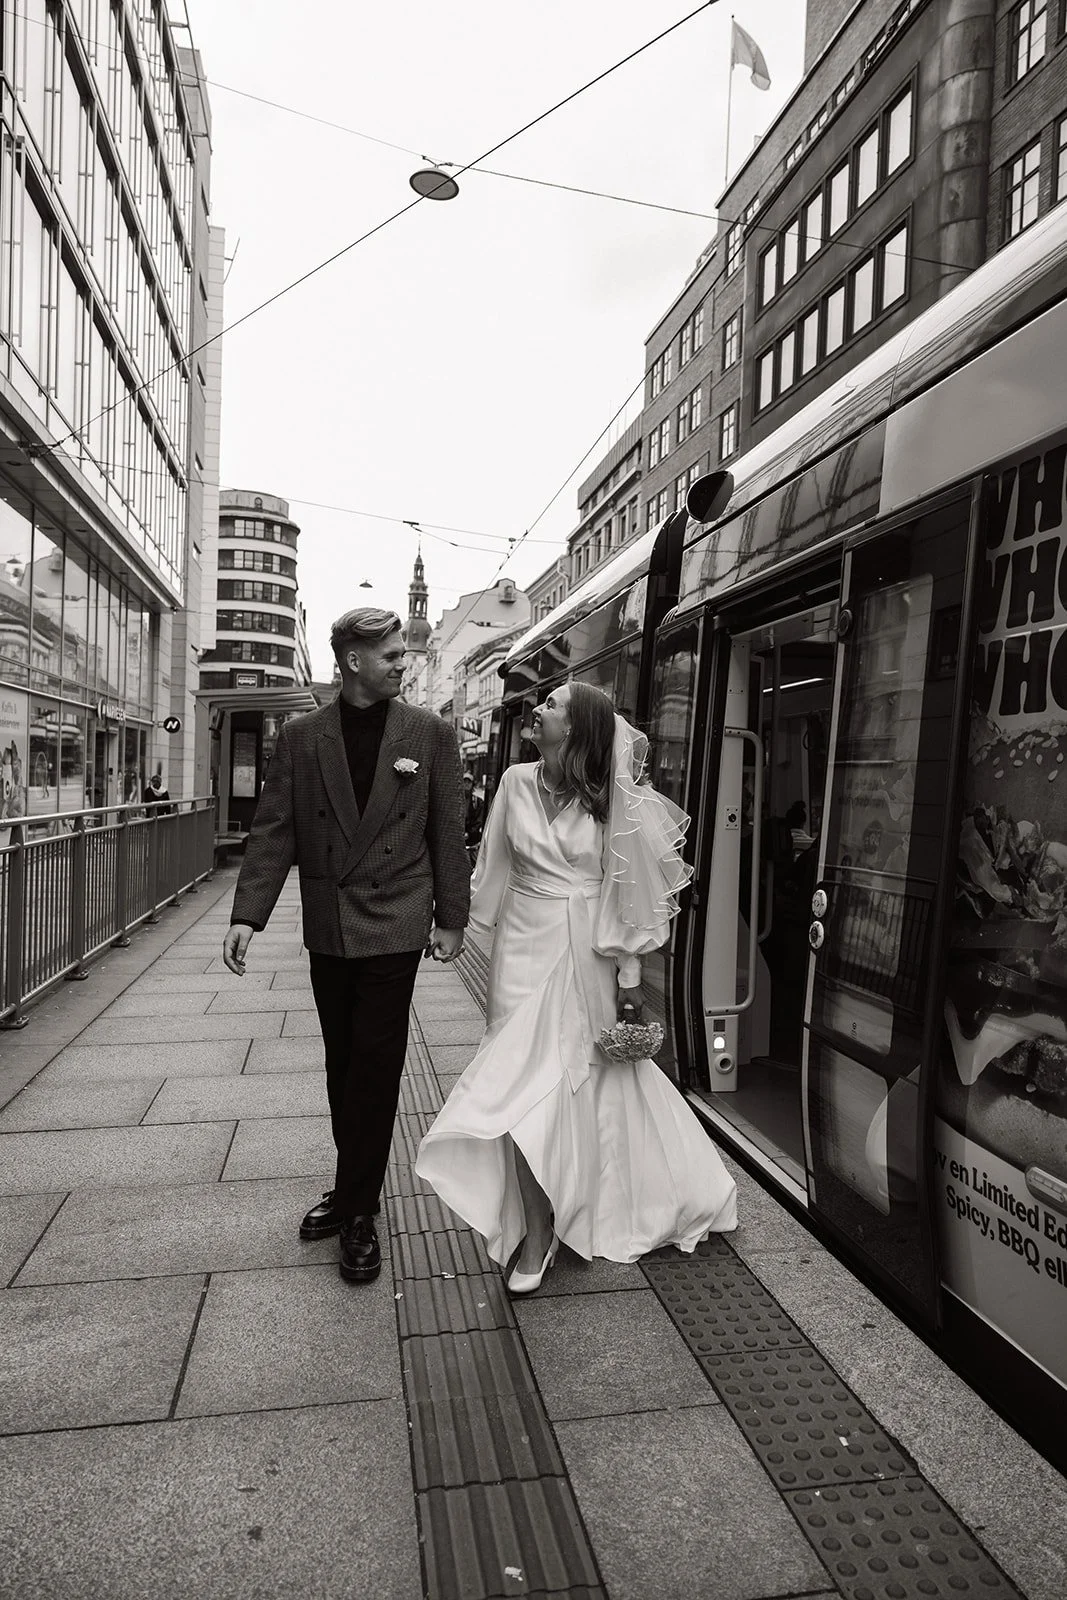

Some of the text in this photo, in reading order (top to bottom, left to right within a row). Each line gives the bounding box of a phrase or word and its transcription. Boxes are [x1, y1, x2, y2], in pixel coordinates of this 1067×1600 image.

[946, 1184, 995, 1240] Spicy,
[997, 1217, 1040, 1274] BBQ
[950, 1160, 969, 1186] en
[973, 1167, 1039, 1232] Limited
[1043, 1211, 1067, 1250] Ed
